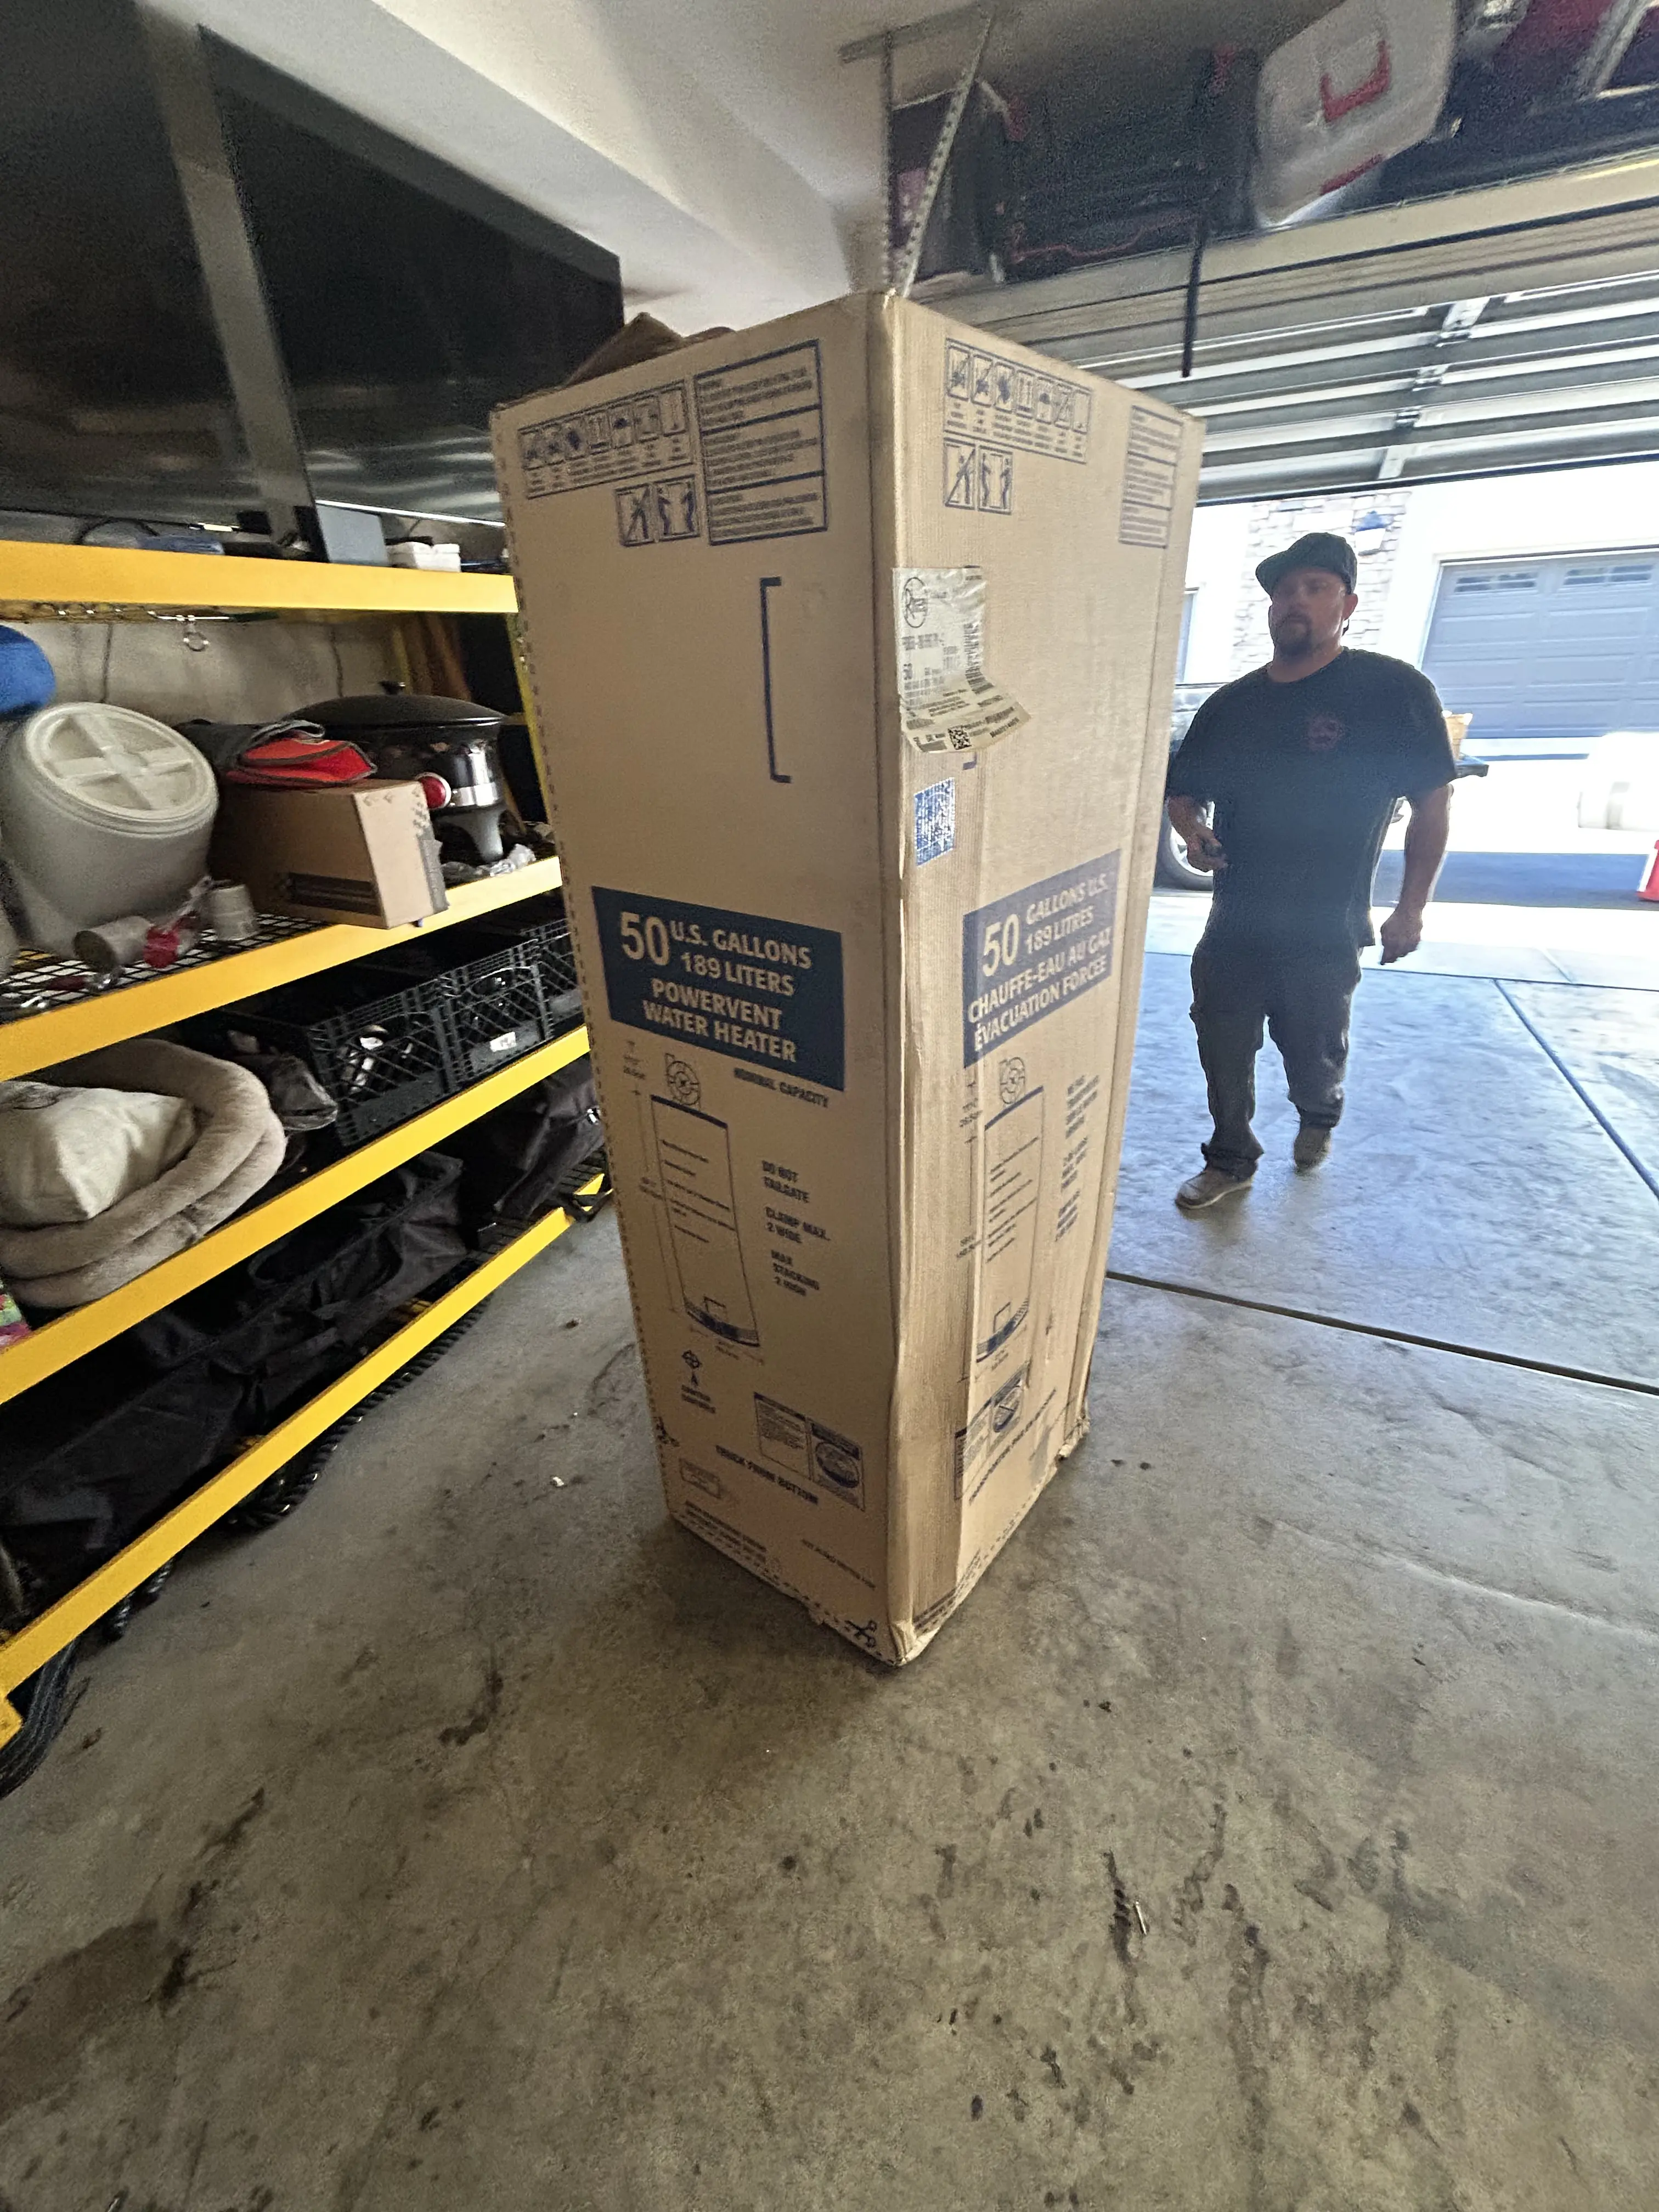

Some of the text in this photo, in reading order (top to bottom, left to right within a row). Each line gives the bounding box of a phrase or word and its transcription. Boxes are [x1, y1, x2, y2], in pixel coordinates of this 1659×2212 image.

[1025, 905, 1093, 954] 189 LITRES
[1026, 882, 1086, 925] GALLONS
[620, 911, 812, 969] 50 U.S. GALLONS
[983, 913, 1019, 976] 50
[681, 952, 794, 996] 189 LITERS
[968, 926, 1112, 1023] CHAUFFE-EAU AU GAZ
[642, 1000, 797, 1063] WATER HEATER
[651, 978, 782, 1030] POWERVENT
